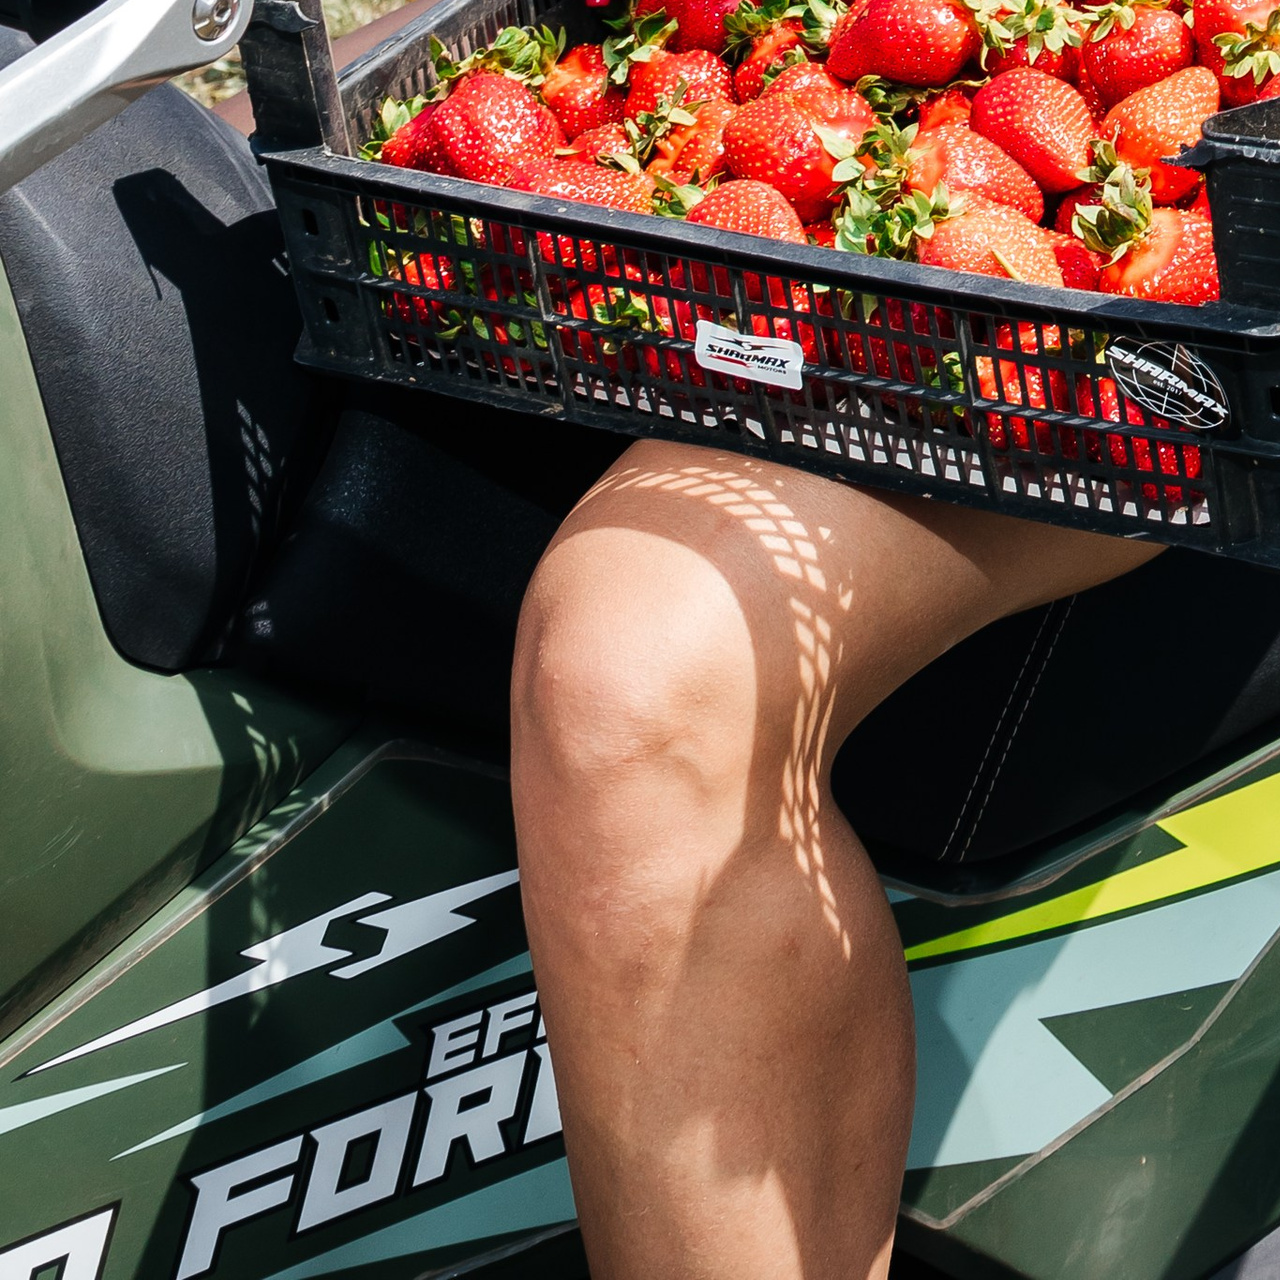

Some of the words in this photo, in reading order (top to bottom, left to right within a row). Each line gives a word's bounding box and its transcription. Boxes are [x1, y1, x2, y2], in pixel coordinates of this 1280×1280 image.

[706, 343, 791, 369] SHARMAX
[757, 364, 787, 375] MOTORS
[1105, 345, 1229, 418] SHARMAX
